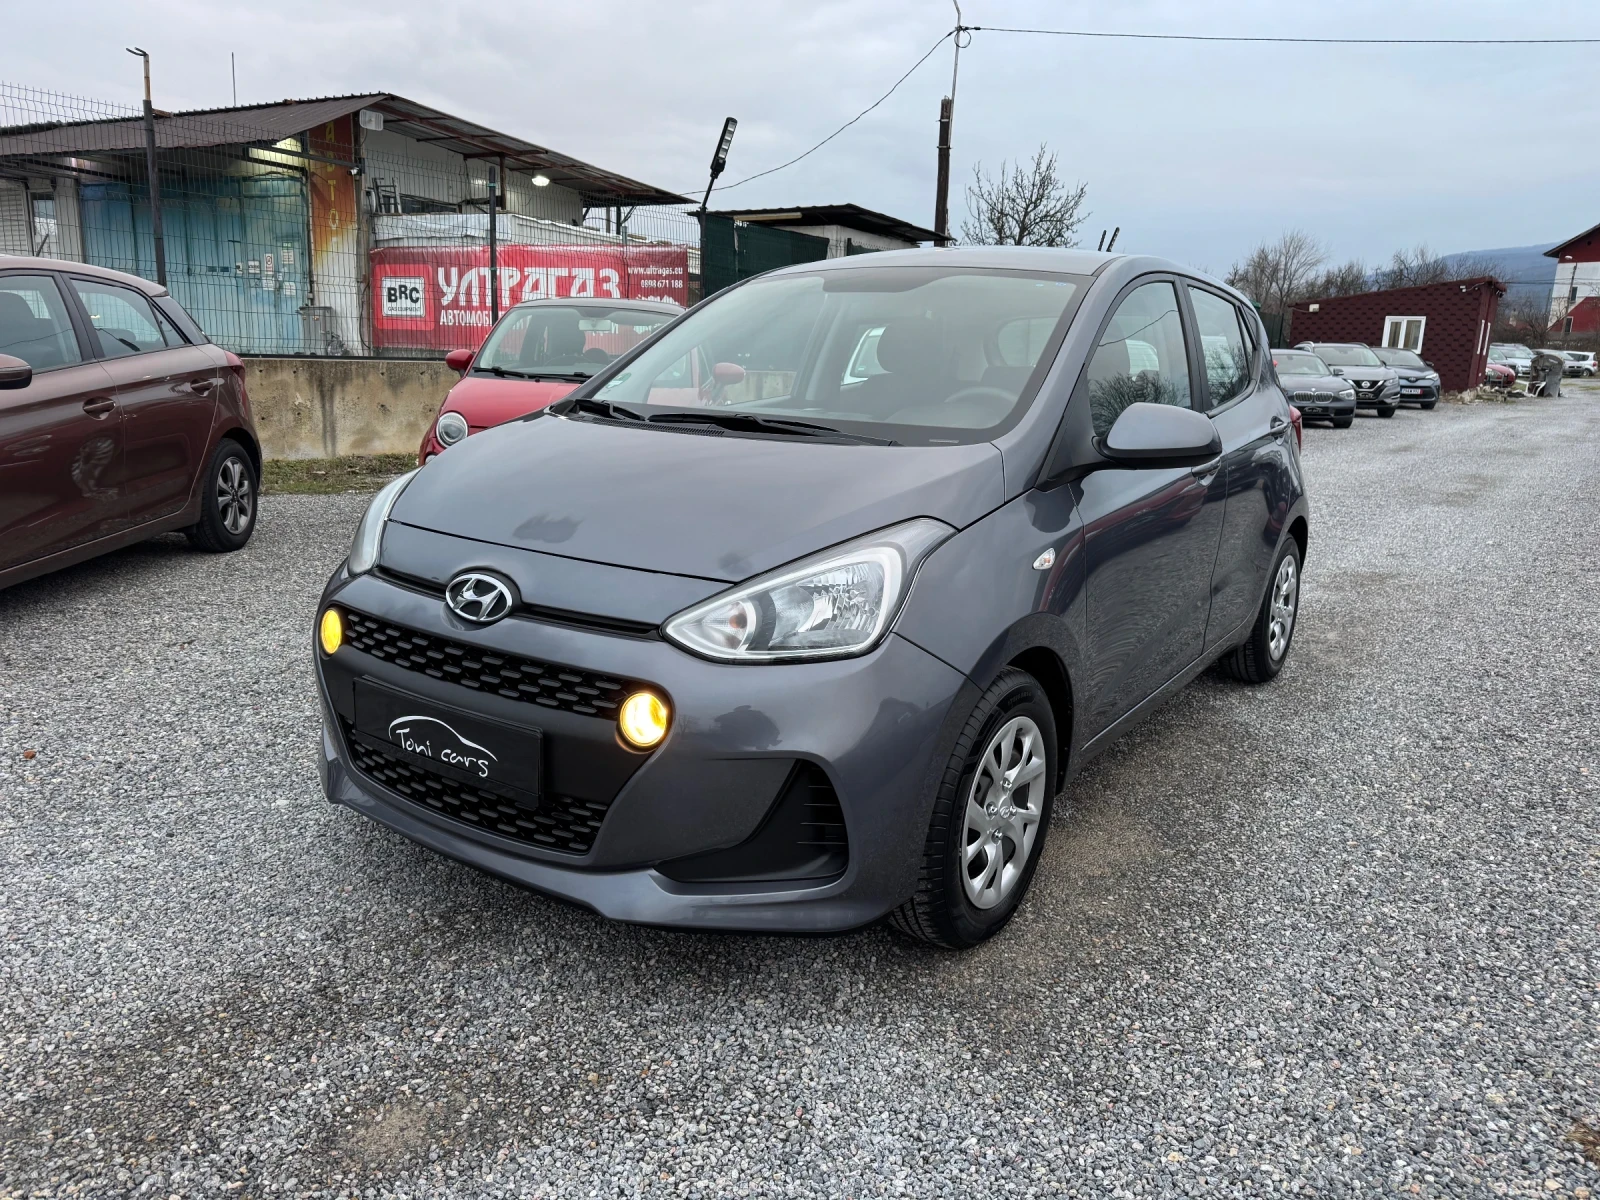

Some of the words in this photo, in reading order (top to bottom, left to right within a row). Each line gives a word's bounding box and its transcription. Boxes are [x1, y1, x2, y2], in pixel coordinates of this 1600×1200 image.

[325, 121, 339, 242] АВТО
[627, 265, 683, 276] www.ultragas.eu
[657, 280, 669, 288] 671
[671, 280, 683, 288] 188
[387, 284, 420, 303] BRC
[438, 267, 620, 306] УЛТРАГАЗ
[396, 728, 432, 757] Toni
[440, 749, 489, 777] cars
